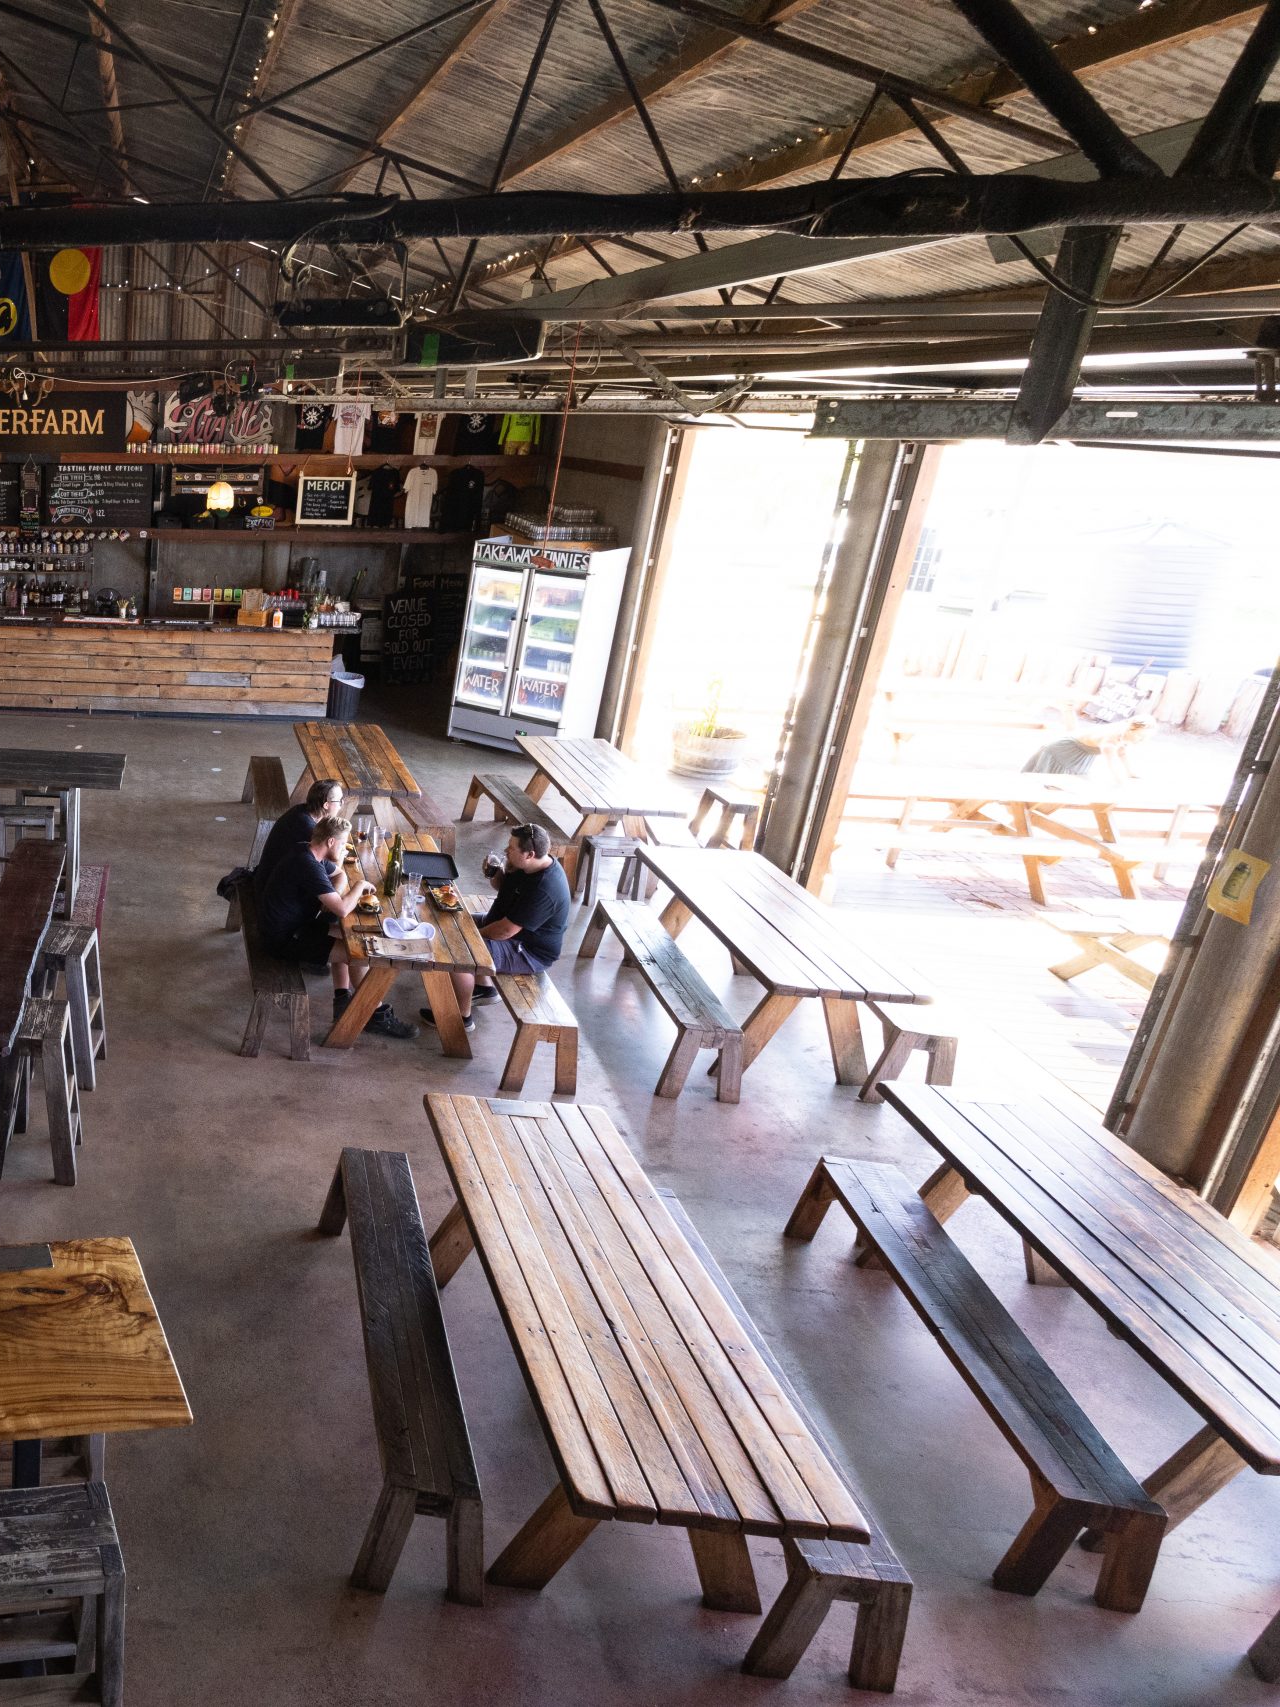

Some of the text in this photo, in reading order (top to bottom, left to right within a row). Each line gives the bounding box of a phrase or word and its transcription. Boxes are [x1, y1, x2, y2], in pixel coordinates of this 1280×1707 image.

[307, 481, 345, 491] MERCH
[478, 543, 540, 564] TAKEAWAY
[390, 597, 428, 614] VENUE
[387, 613, 431, 629] CLOSED
[399, 628, 419, 640] FOR
[384, 639, 435, 655] SOLD OUT
[464, 674, 499, 693] WATER
[521, 676, 559, 697] WATER
